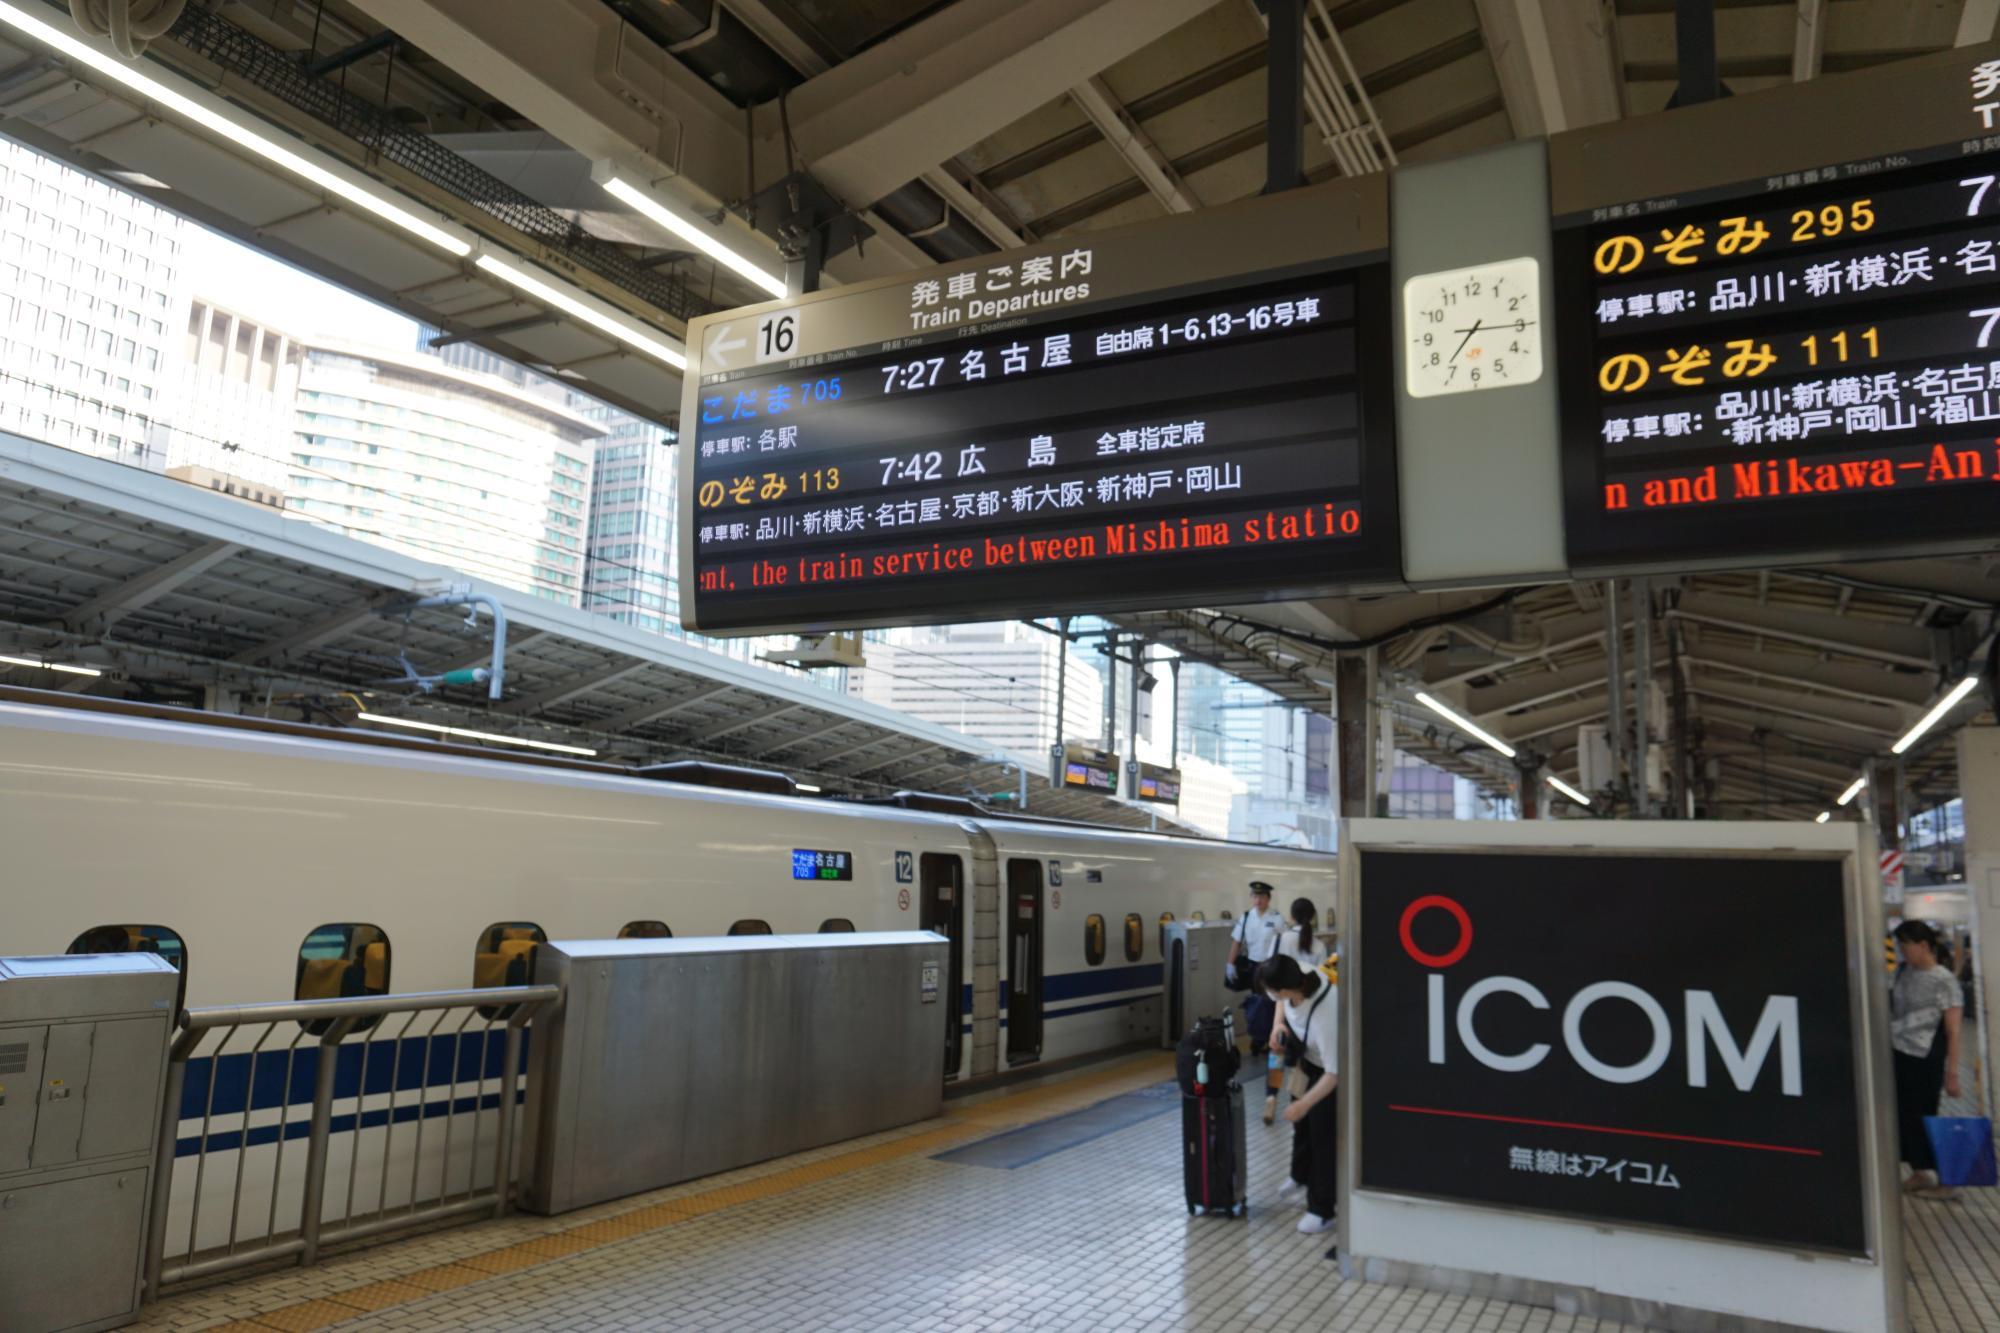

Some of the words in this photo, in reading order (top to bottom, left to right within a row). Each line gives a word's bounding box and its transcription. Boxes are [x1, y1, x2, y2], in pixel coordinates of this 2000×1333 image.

[1844, 159, 1882, 176] Train
[1885, 154, 1911, 169] No.
[1646, 196, 1678, 214] Train
[1593, 216, 1770, 274] のぞみ
[1790, 198, 1875, 242] 295
[911, 249, 1093, 309] 発車ご案内
[1463, 282, 1481, 297] 12
[1492, 285, 1499, 298] 1
[910, 306, 961, 331] Train
[968, 282, 1091, 319] Departures
[1442, 292, 1456, 306] 11
[1508, 297, 1519, 312] 2
[981, 316, 1028, 333] Destination
[1428, 309, 1444, 323] 10
[1515, 318, 1526, 333] 3
[761, 315, 795, 356] 16
[903, 337, 923, 349] Time
[1423, 333, 1433, 346] 9
[1509, 340, 1519, 353] 4
[1430, 352, 1441, 366] 8
[1494, 358, 1504, 373] 5
[1599, 338, 1777, 393] のぞみ
[1800, 327, 1880, 367] 111
[702, 383, 794, 424] こだま
[801, 377, 843, 404] 705
[881, 357, 945, 394] 7:27
[960, 334, 1072, 382] 名古屋
[1448, 365, 1458, 379] 7
[1471, 368, 1481, 381] 6
[758, 425, 798, 453] 各駅
[699, 473, 788, 508] のぞみ
[799, 467, 840, 493] 113
[879, 451, 943, 486] 7:42
[957, 434, 1057, 477] 広島
[1096, 421, 1206, 456] 全車指定席
[1605, 482, 1627, 510] n
[1643, 465, 1717, 507] and
[752, 559, 788, 586] the
[800, 552, 863, 583] train
[872, 543, 974, 576] service
[985, 534, 1096, 567] between
[1105, 517, 1231, 556] Mishima
[1244, 503, 1360, 542] statio
[795, 866, 809, 878] 705
[896, 854, 912, 880] 12
[1508, 1145, 1681, 1190] 無線はアイコム
